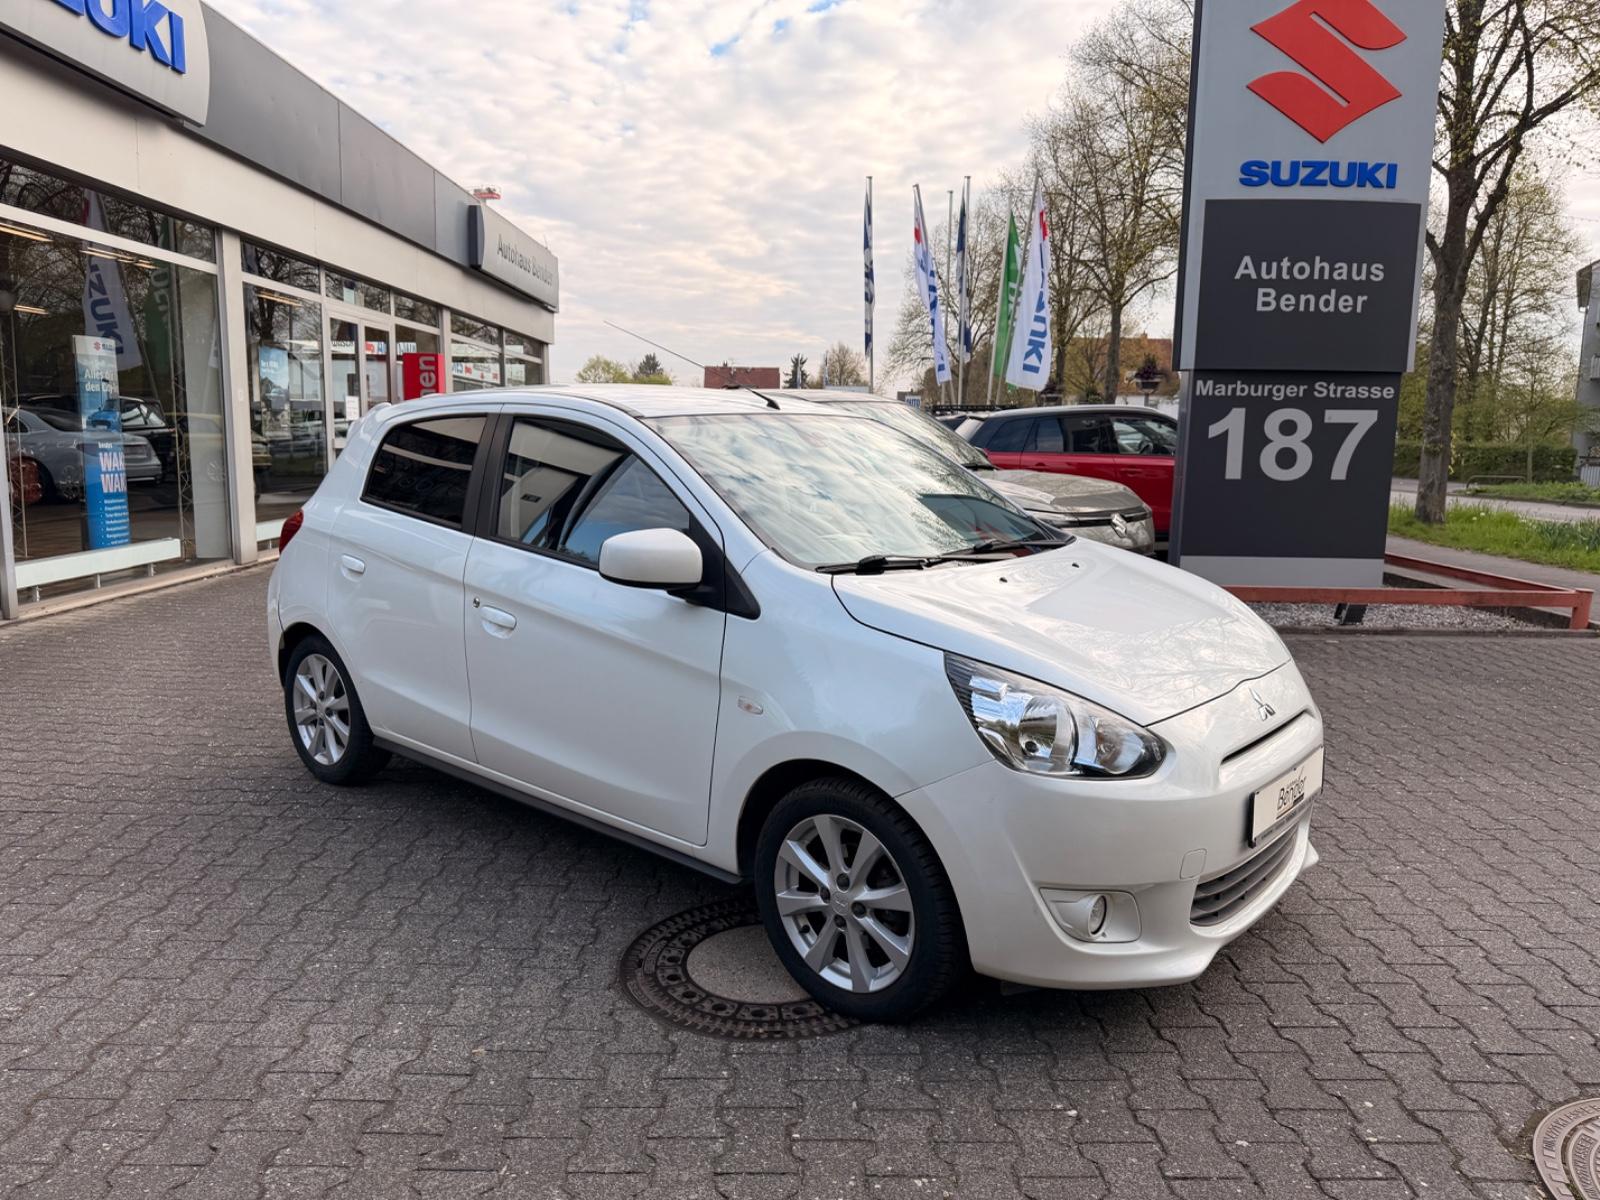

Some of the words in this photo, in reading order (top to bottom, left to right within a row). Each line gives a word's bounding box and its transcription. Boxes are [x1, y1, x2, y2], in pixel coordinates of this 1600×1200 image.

[49, 0, 186, 74] UKI
[1239, 160, 1398, 189] SUZUKI
[496, 233, 531, 273] Autohaus
[1234, 255, 1385, 282] Autohaus
[1256, 287, 1368, 314] Bender
[1195, 379, 1307, 400] Marburger
[1313, 380, 1395, 400] Strasse
[1207, 407, 1378, 482] 187
